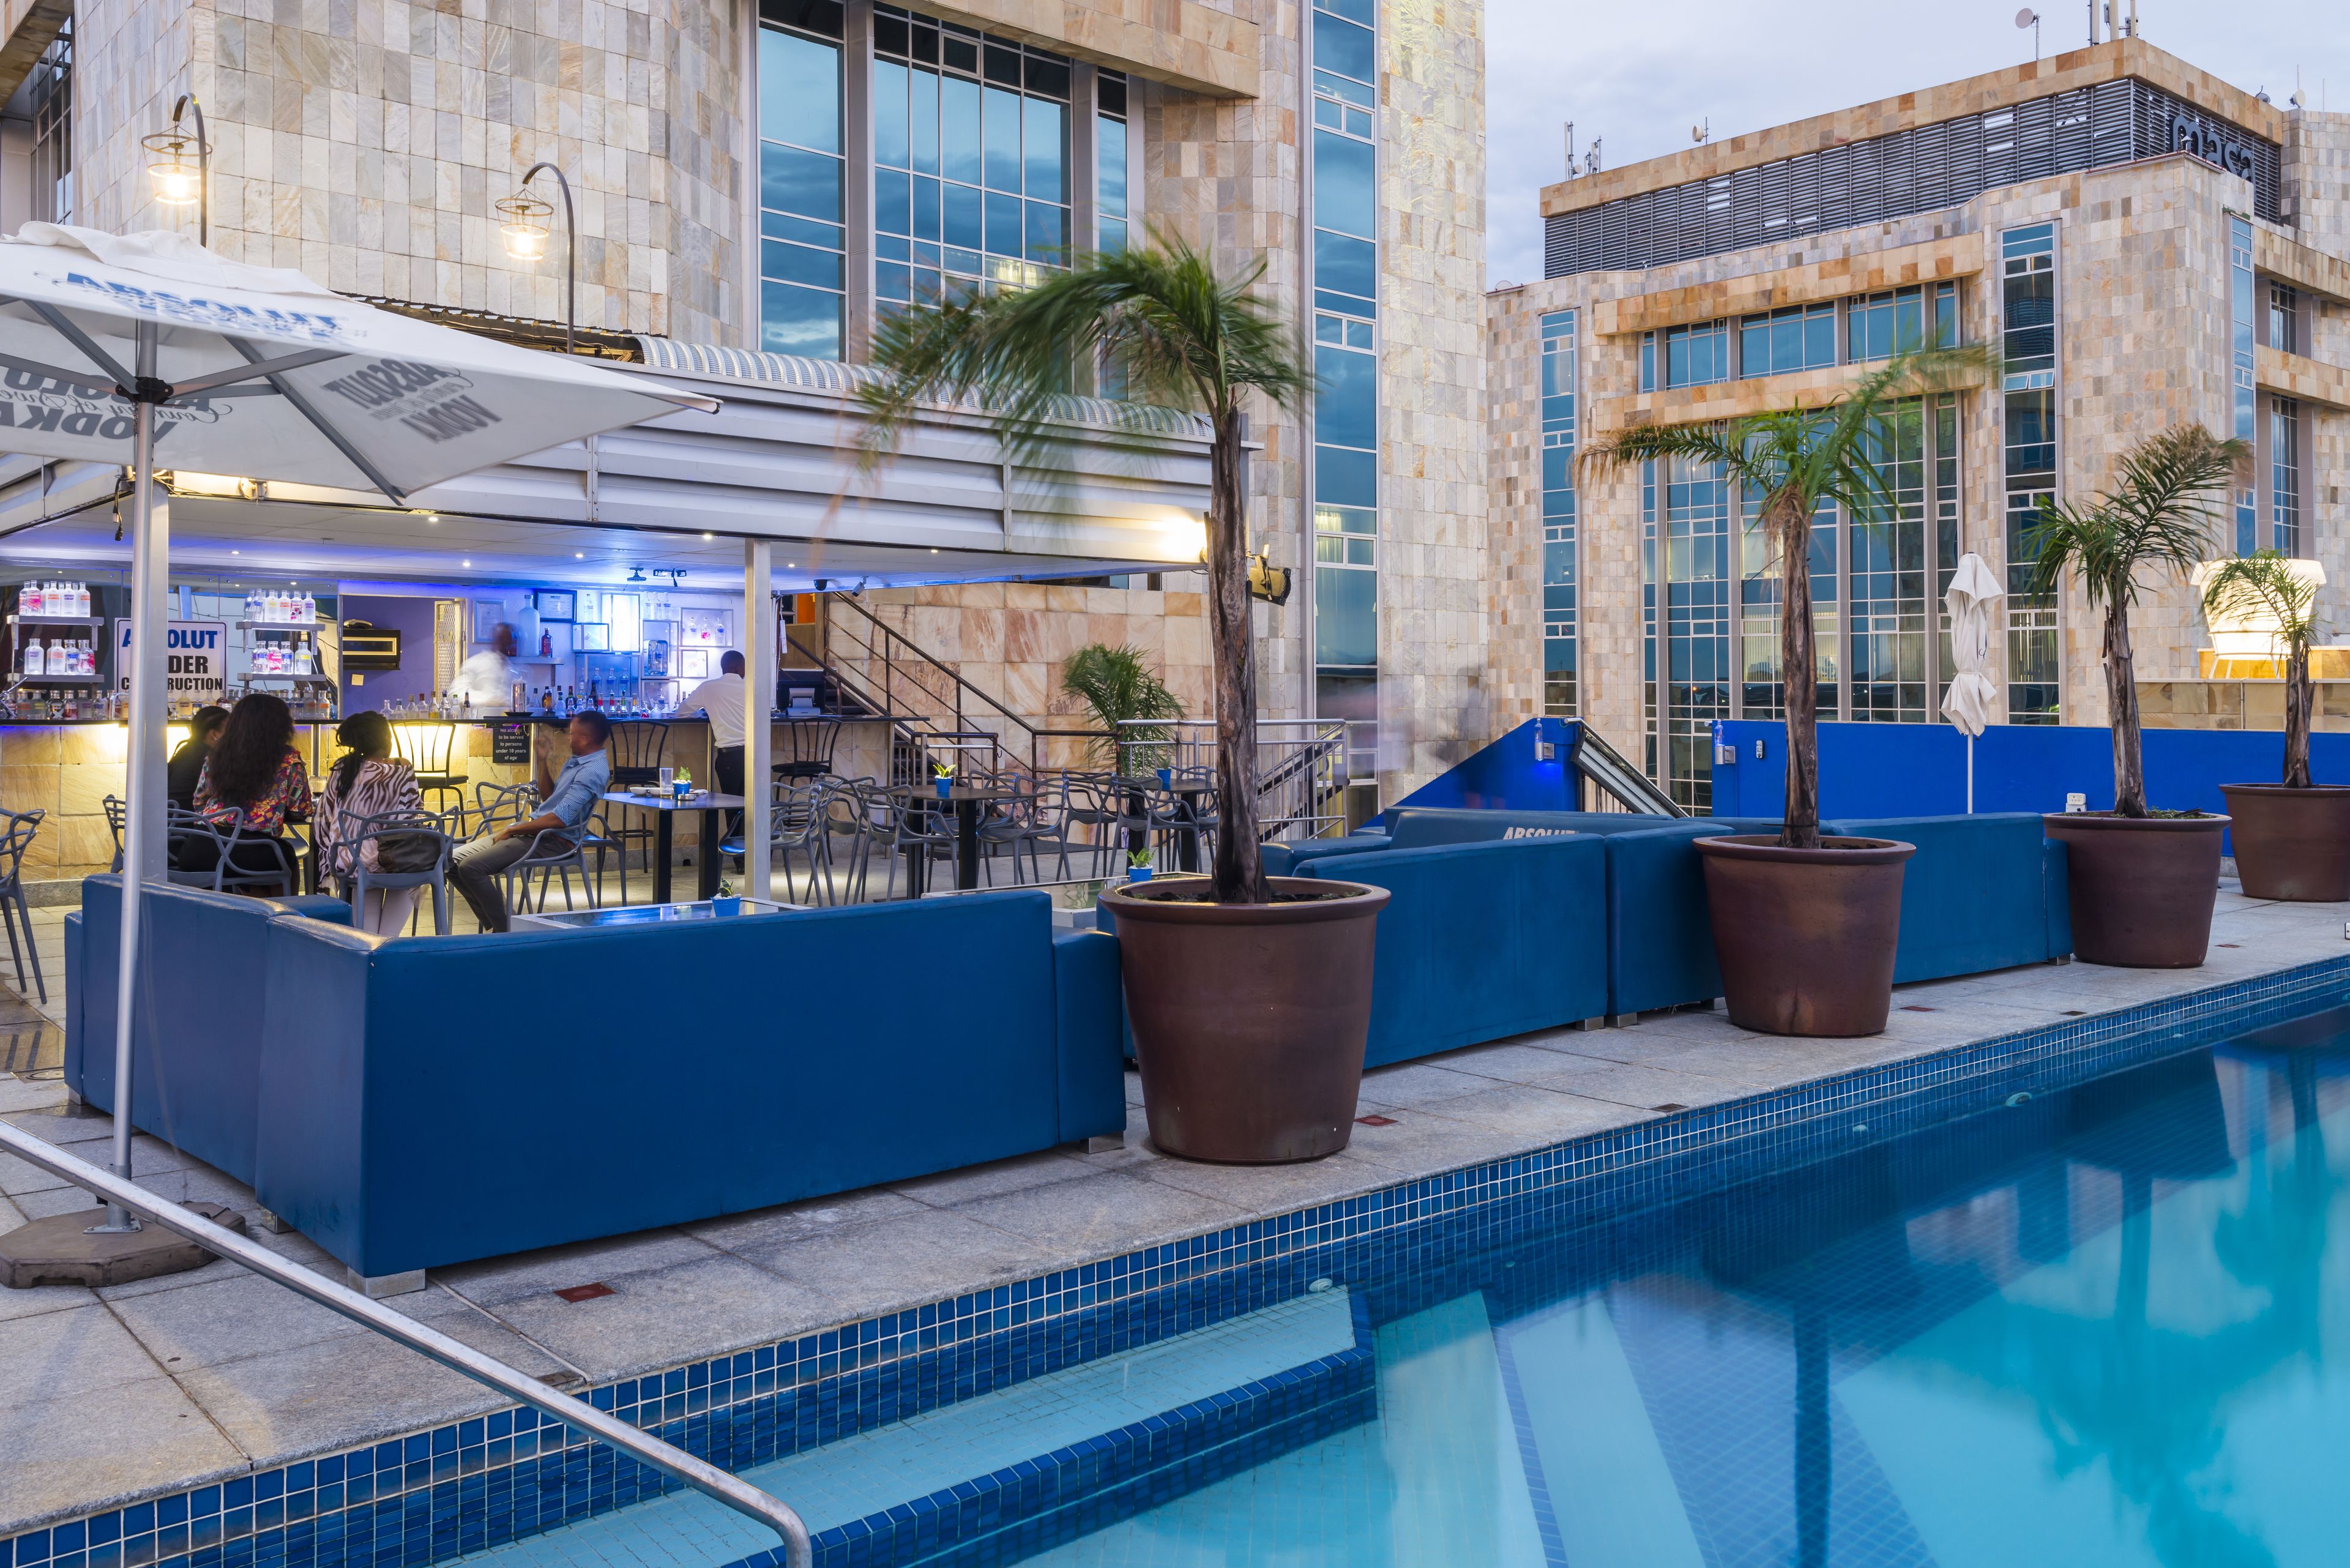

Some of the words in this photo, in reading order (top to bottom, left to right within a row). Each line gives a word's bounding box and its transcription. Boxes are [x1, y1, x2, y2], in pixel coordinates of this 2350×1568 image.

[2171, 115, 2258, 203] masa
[121, 629, 218, 649] AOLUT
[168, 655, 209, 674] DER
